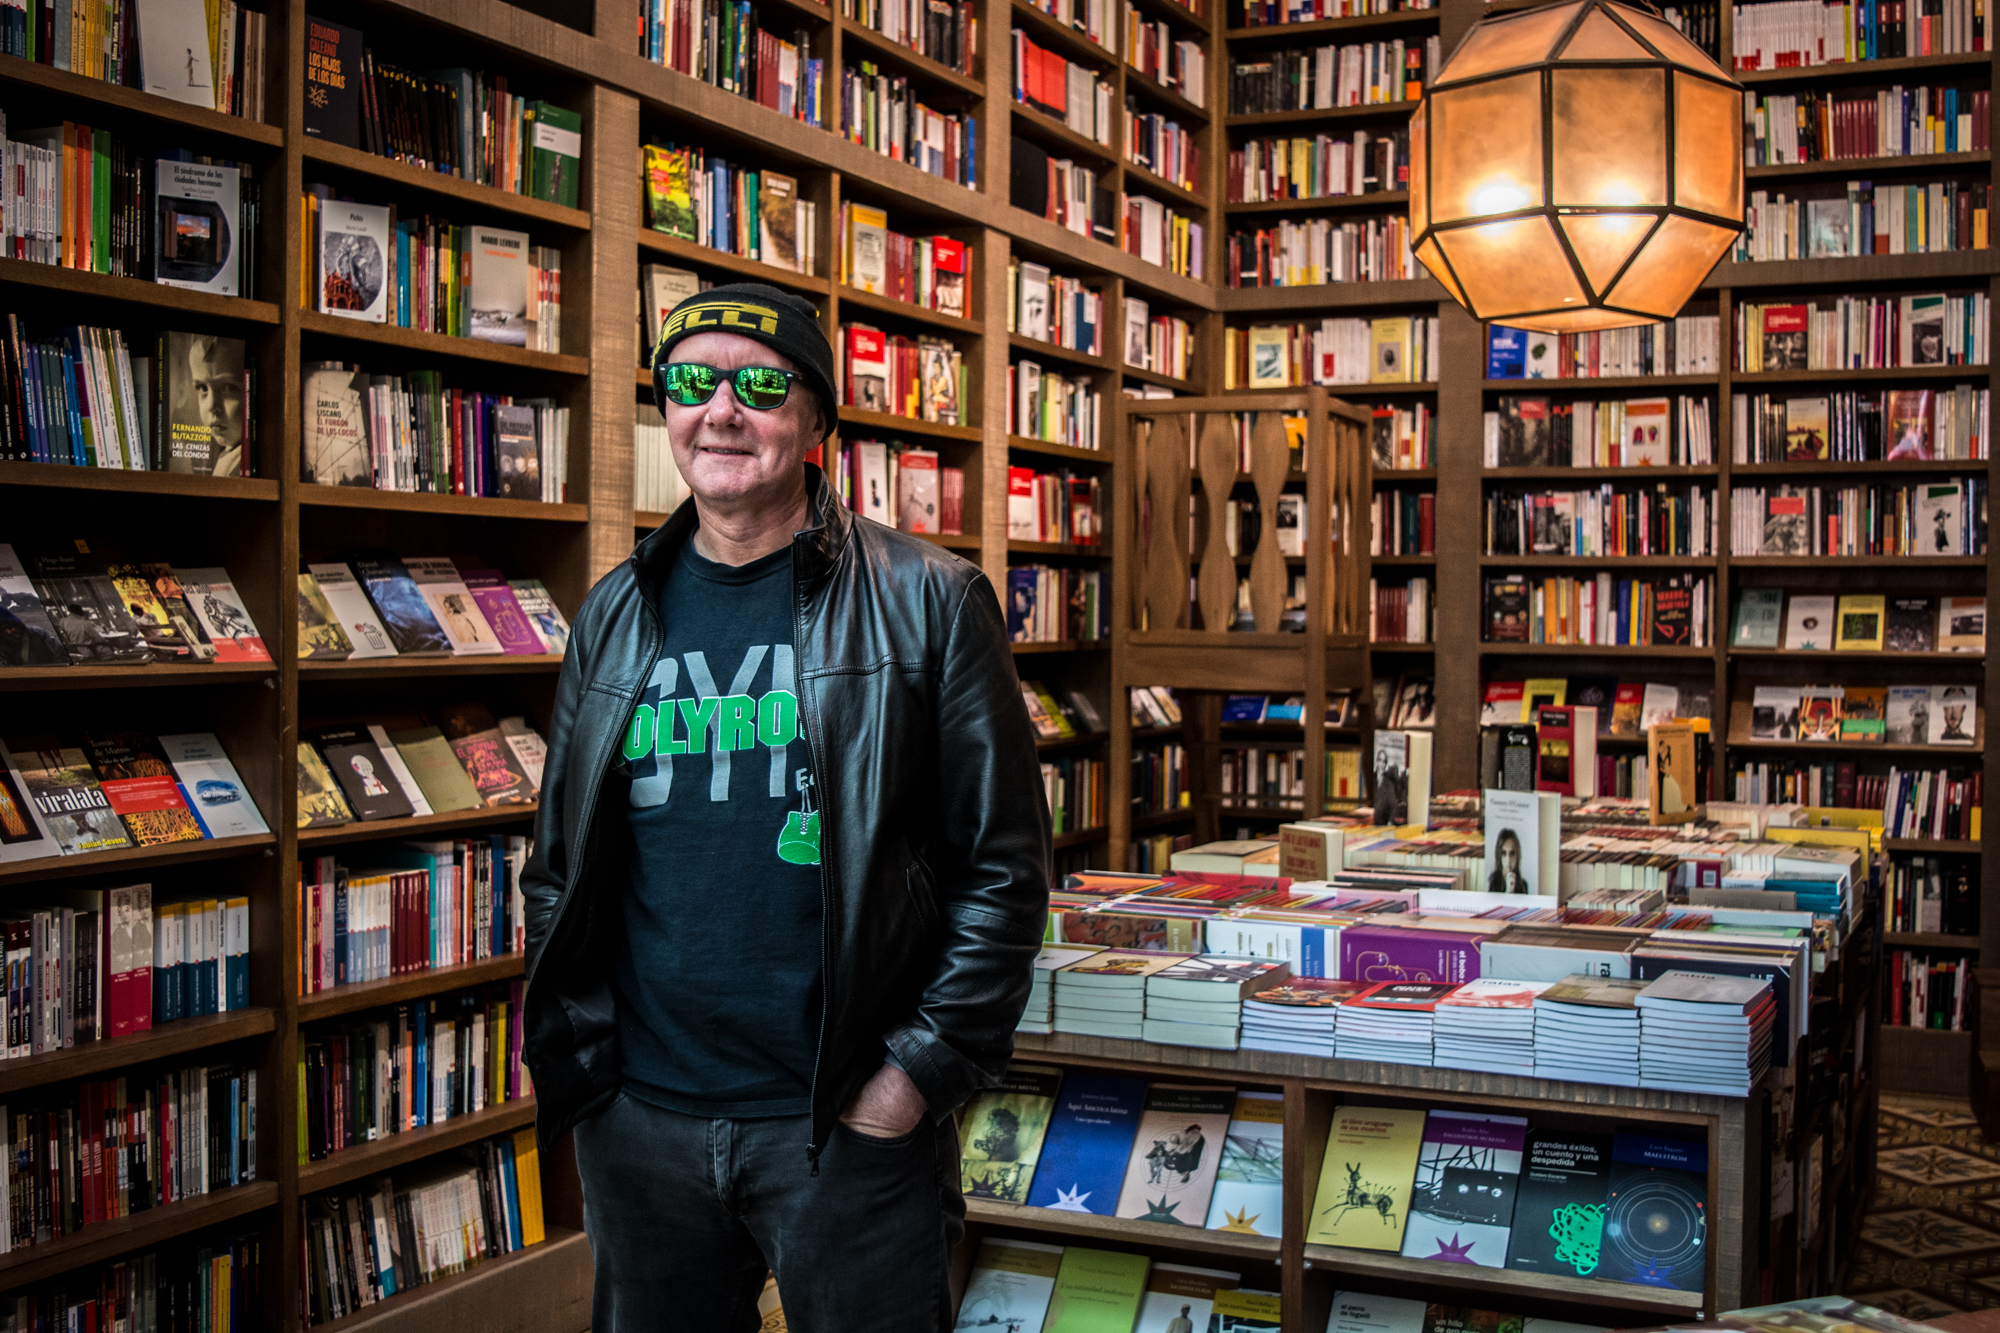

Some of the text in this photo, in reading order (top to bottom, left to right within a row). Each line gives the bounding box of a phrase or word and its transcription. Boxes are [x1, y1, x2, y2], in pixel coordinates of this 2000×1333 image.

[310, 22, 340, 44] EDUARDO
[310, 37, 337, 58] GALEANO
[309, 51, 342, 74] LOS HIJOS
[308, 66, 316, 81] DE
[317, 68, 330, 85] LOS
[174, 176, 222, 188] ciudades hermosas
[317, 400, 340, 409] CARLOS
[317, 409, 342, 418] LISCANO
[172, 423, 211, 434] FERNANDO
[317, 426, 358, 437] DE LOS LOCOS
[172, 432, 211, 442] BUTAZZONI
[186, 443, 210, 452] CENIZAS
[618, 690, 805, 763] OLYRO
[34, 787, 108, 814] viralata
[1533, 1141, 1597, 1154] grandes éxitos,
[1545, 1150, 1574, 1158] cuento
[1644, 1151, 1688, 1162] MAELSTROM
[1531, 1157, 1575, 1167] despedida
[1448, 1318, 1463, 1327] hilo
